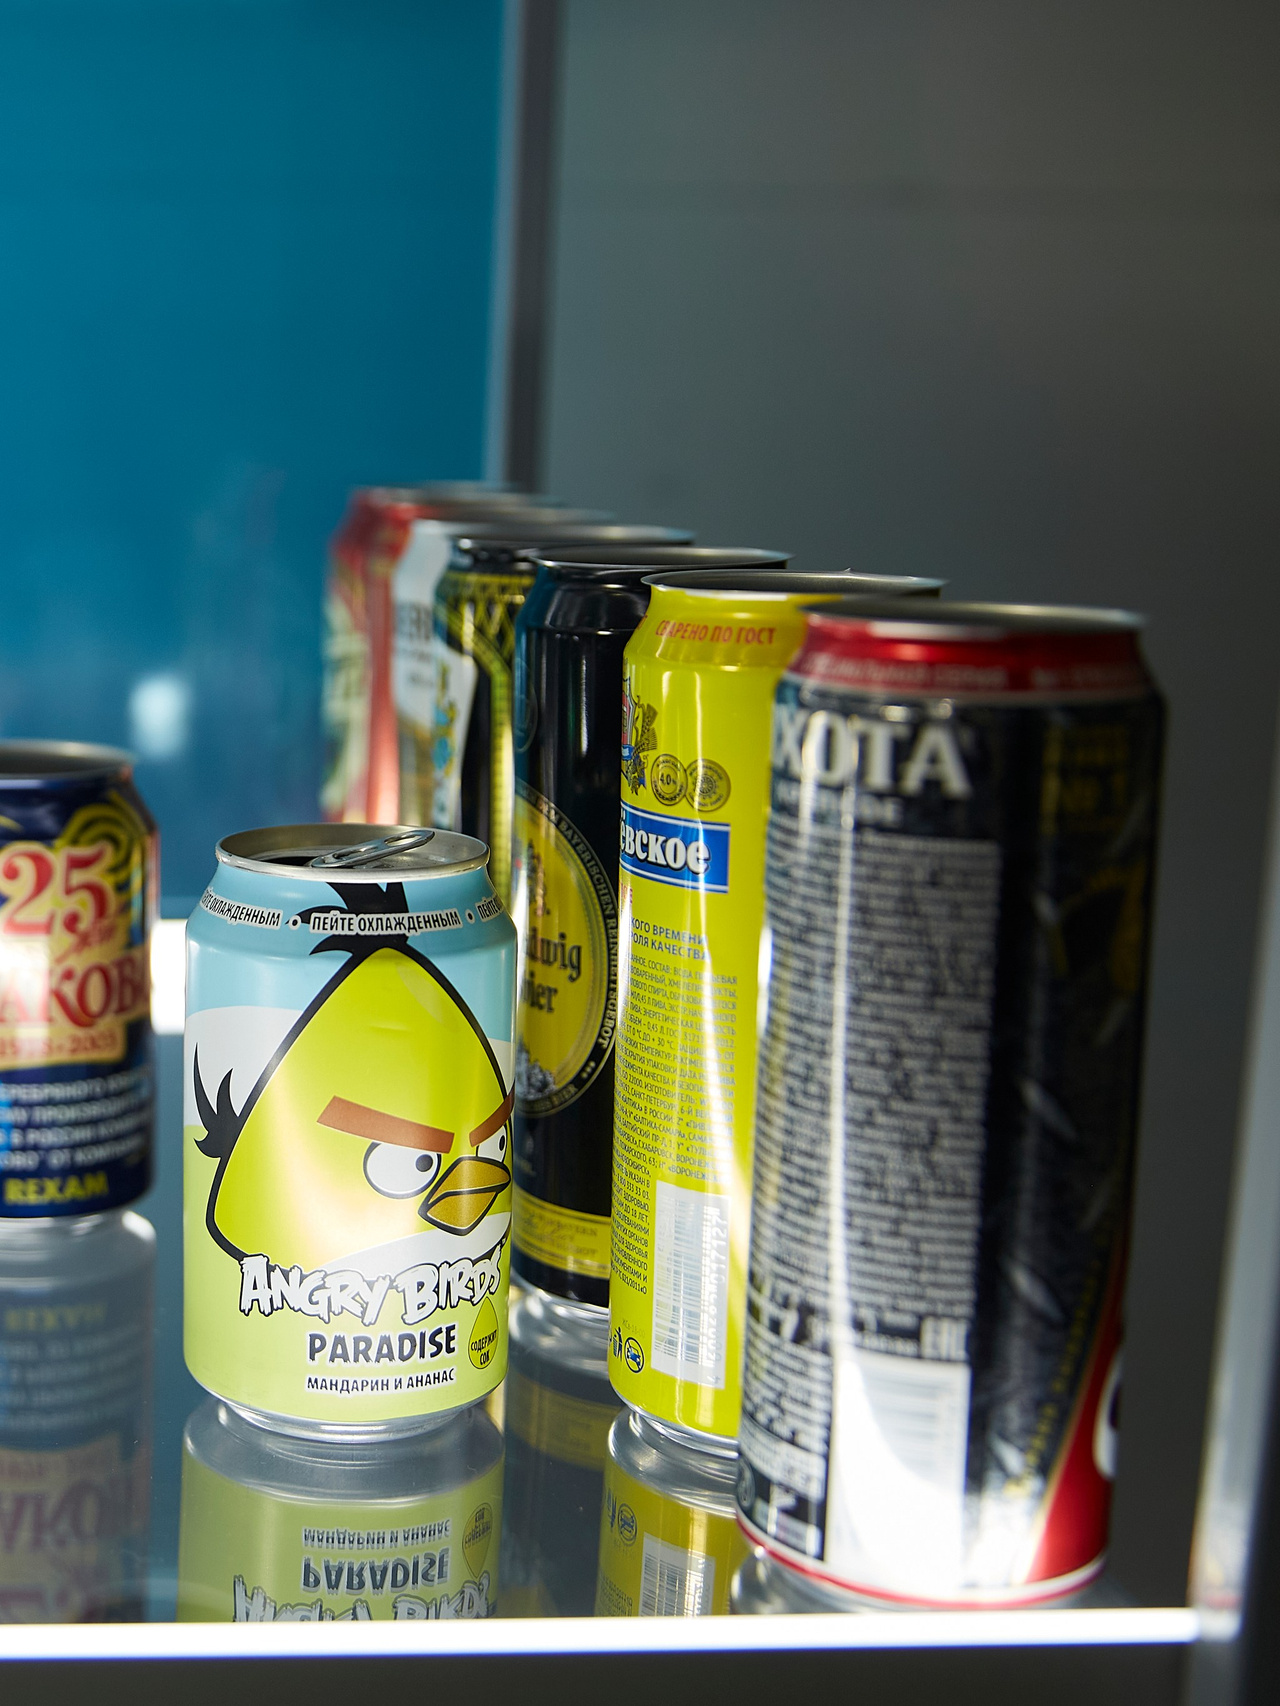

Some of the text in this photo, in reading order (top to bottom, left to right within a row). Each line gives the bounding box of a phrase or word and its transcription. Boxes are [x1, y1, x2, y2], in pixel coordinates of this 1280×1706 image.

[656, 619, 708, 641] СВАРЕНО
[710, 625, 732, 643] ПО
[736, 626, 777, 645] ГОСТ
[774, 707, 971, 797] ХОТА
[620, 808, 710, 875] ёвское
[2, 852, 111, 935] 25
[311, 911, 355, 932] ПЕЙТЕ
[357, 910, 462, 934] ОХЛАЖДЕННЫМ
[631, 917, 707, 947] КОГО ВРЕМЕНИ
[651, 938, 710, 962] КАЧЕСТВА
[4, 1172, 109, 1204] REXAM
[239, 1244, 501, 1327] ANGRY BIRDS
[308, 1324, 456, 1363] PARADISE
[470, 1329, 498, 1353] СОДЕРЖИТ
[479, 1352, 490, 1366] СОК
[307, 1367, 455, 1394] МАНДАРИН И АНАНАС
